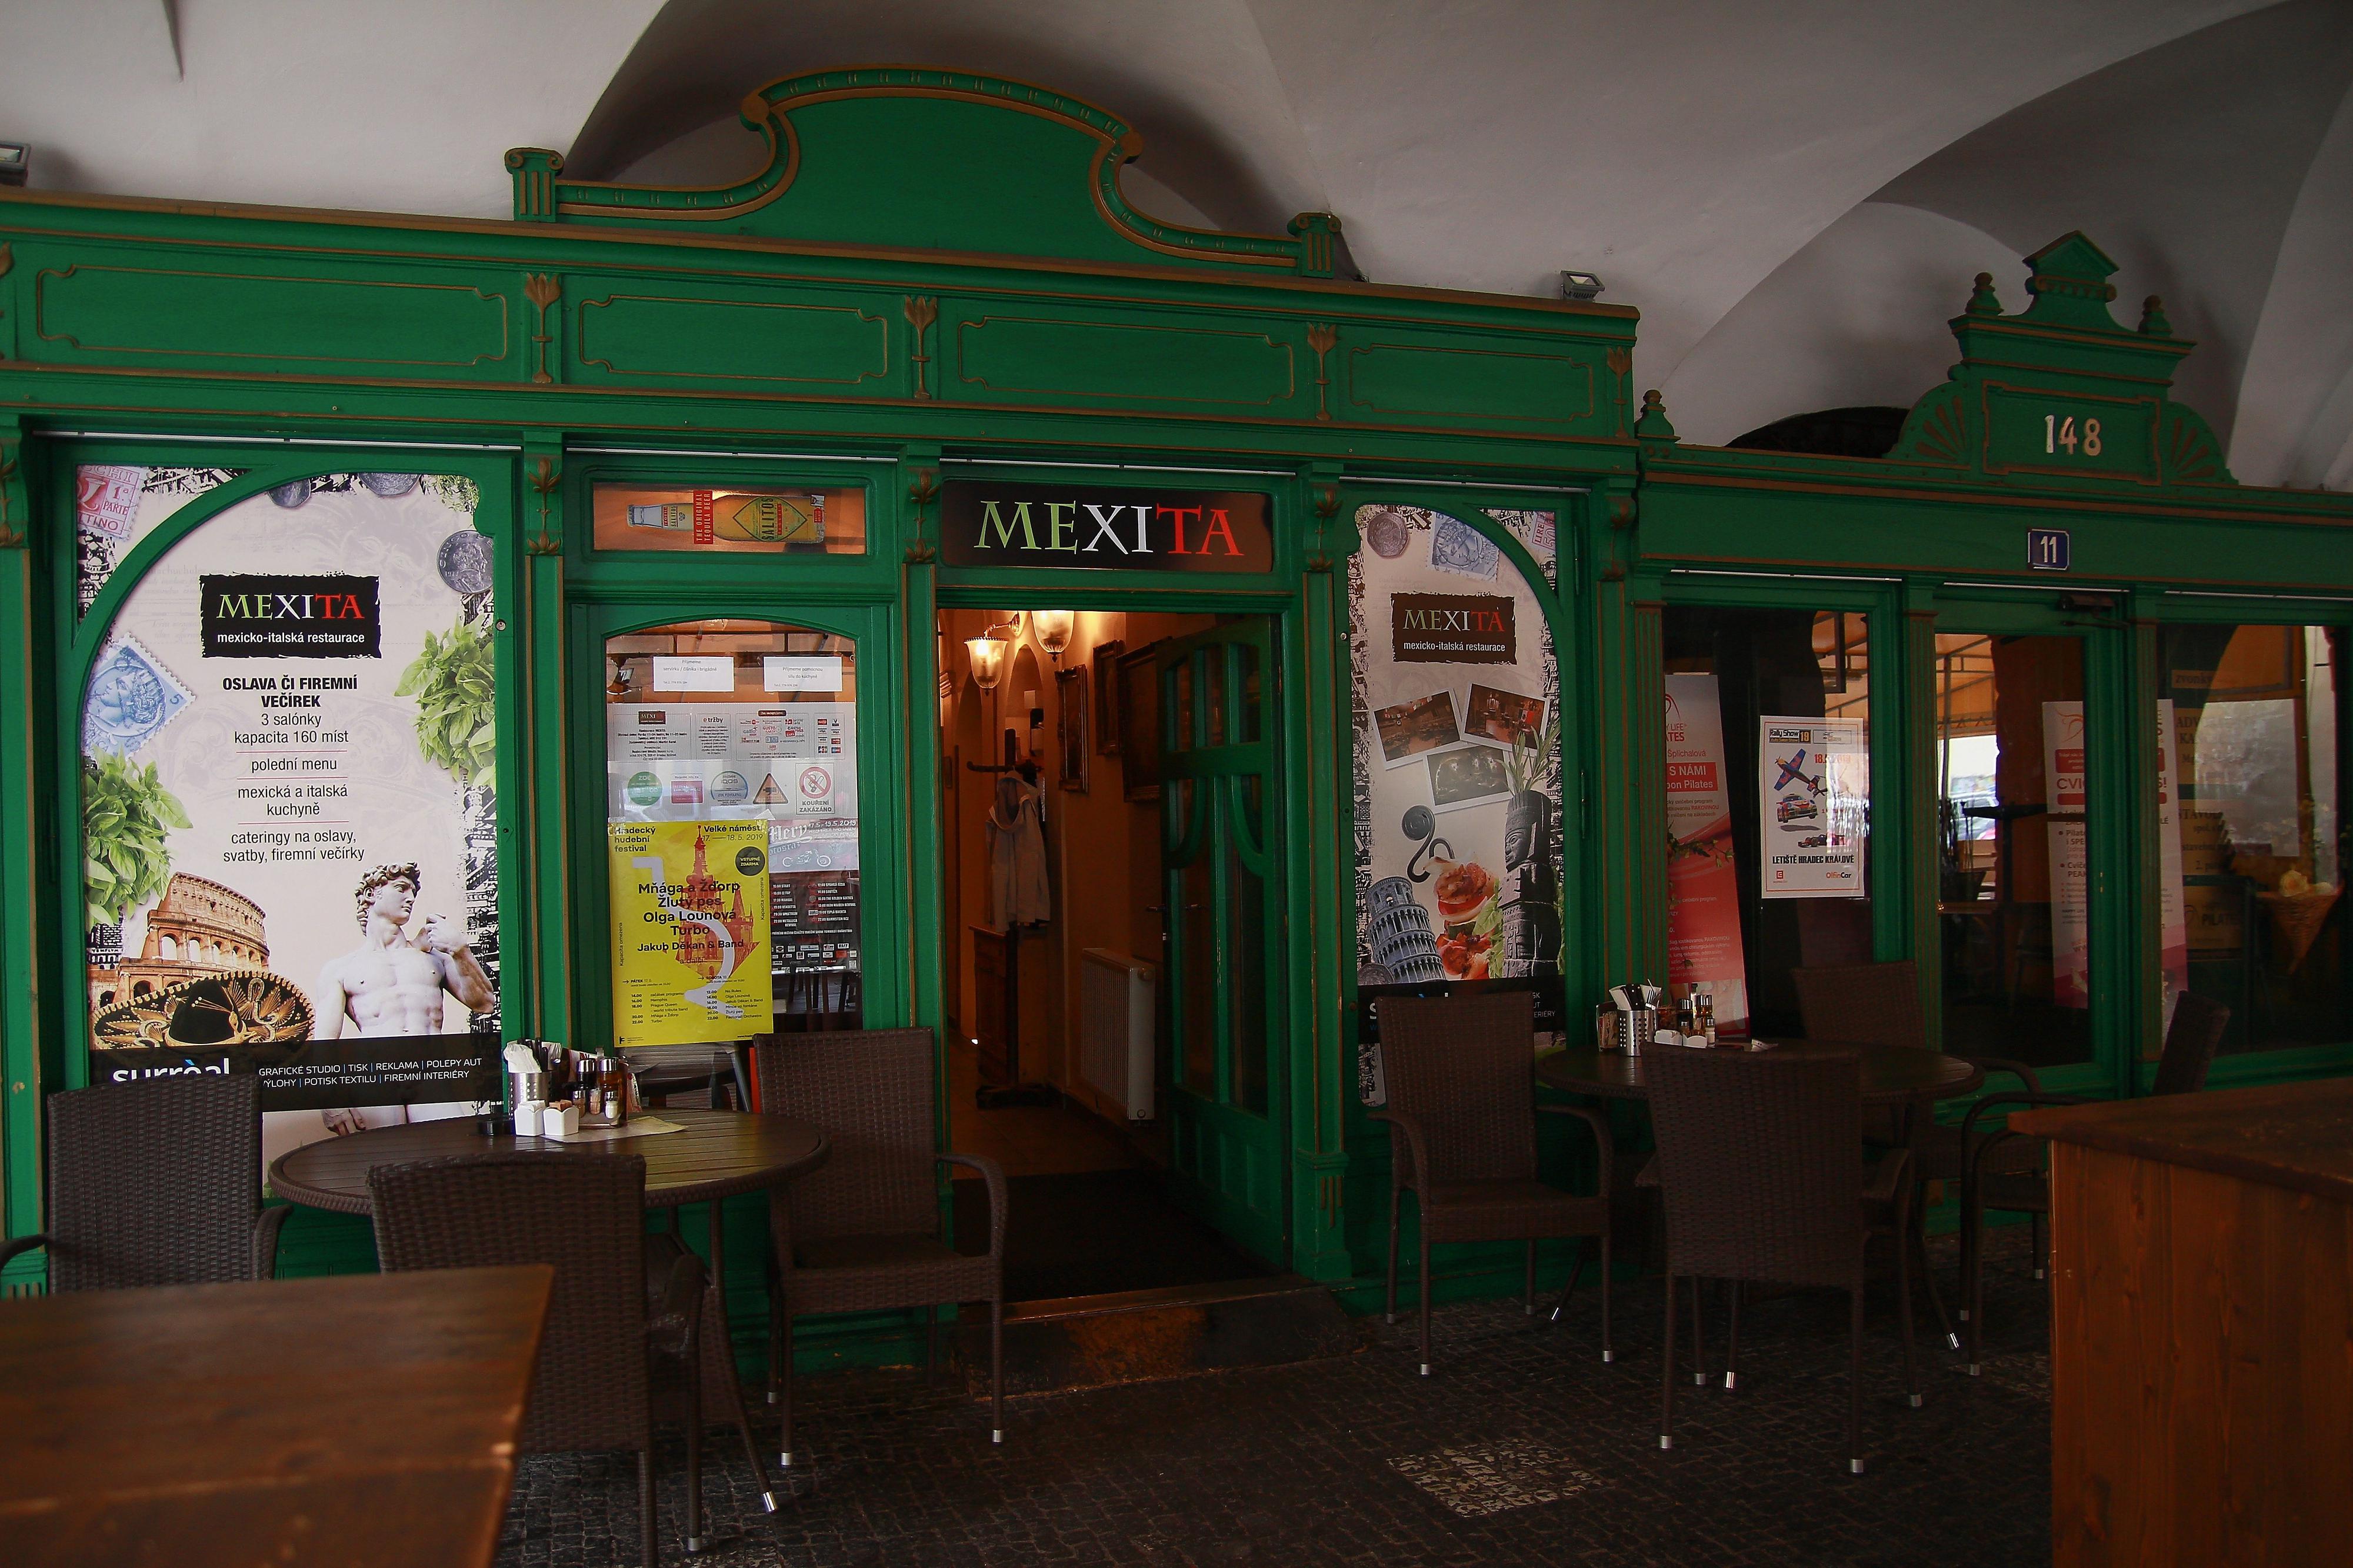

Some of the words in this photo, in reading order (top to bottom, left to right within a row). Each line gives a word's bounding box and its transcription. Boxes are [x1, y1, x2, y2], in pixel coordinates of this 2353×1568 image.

[2044, 414, 2102, 456] 148
[103, 500, 129, 515] PARTE
[762, 497, 774, 541] SALITOS
[974, 500, 1245, 555] MEXITA
[2039, 536, 2057, 564] 11
[216, 593, 365, 620] MEXITA
[1402, 609, 1505, 632] MEXITA
[218, 631, 304, 643] mexicko-italská
[307, 632, 365, 643] restaurace
[1404, 641, 1464, 650] mexicko-italská
[1466, 643, 1505, 652] restaurace
[222, 678, 277, 690] OSLAVA
[281, 675, 295, 689] ČI
[300, 675, 358, 689] FIREMNÍ
[261, 692, 321, 708] VEČÍREK
[261, 713, 269, 725] 3
[274, 713, 322, 728] salónky
[235, 731, 289, 746] kapacita
[294, 730, 317, 743] 160
[322, 729, 349, 742] míst
[1770, 729, 1783, 738] Rally
[1800, 731, 1809, 742] 19
[251, 758, 298, 773] polední
[302, 759, 337, 770] menu
[1669, 766, 1677, 776] S
[1679, 764, 1707, 776] NÁMI
[238, 785, 291, 798] mexická
[295, 789, 303, 798] a
[306, 784, 348, 798] italská
[1684, 779, 1714, 789] Pilates
[2057, 778, 2083, 789] CVI
[267, 802, 320, 818] kuchyně
[231, 830, 290, 845] cateringy
[295, 833, 309, 842] na
[314, 830, 356, 845] oslavy,
[615, 826, 656, 835] Hradecký
[224, 849, 268, 863] svatby,
[272, 848, 316, 861] firemní
[320, 846, 365, 862] večírky
[1772, 854, 1797, 864] LETIŠTĚ
[1798, 855, 1824, 864] HRADEC
[1825, 854, 1854, 863] KRÁLOVÉ
[638, 882, 683, 896] Mňága
[701, 879, 739, 895] Žďorp
[658, 895, 692, 908] Žlutý
[698, 897, 721, 908] pes
[644, 912, 675, 925] Olga
[679, 909, 735, 921] Lounová
[671, 925, 710, 935] Turbo
[638, 942, 669, 952] Jakub
[672, 940, 705, 950] Děkan
[718, 939, 744, 948] Band
[259, 1065, 304, 1076] GRAFICKÉ
[306, 1065, 341, 1074] STUDIO
[348, 1063, 368, 1072] TISK
[376, 1062, 419, 1070] REKLAMA
[304, 1077, 338, 1086] POTISK
[339, 1075, 376, 1084] TEXTILU
[384, 1072, 421, 1082] FIREMNÍ
[424, 1070, 469, 1080] INTERIÉRY
